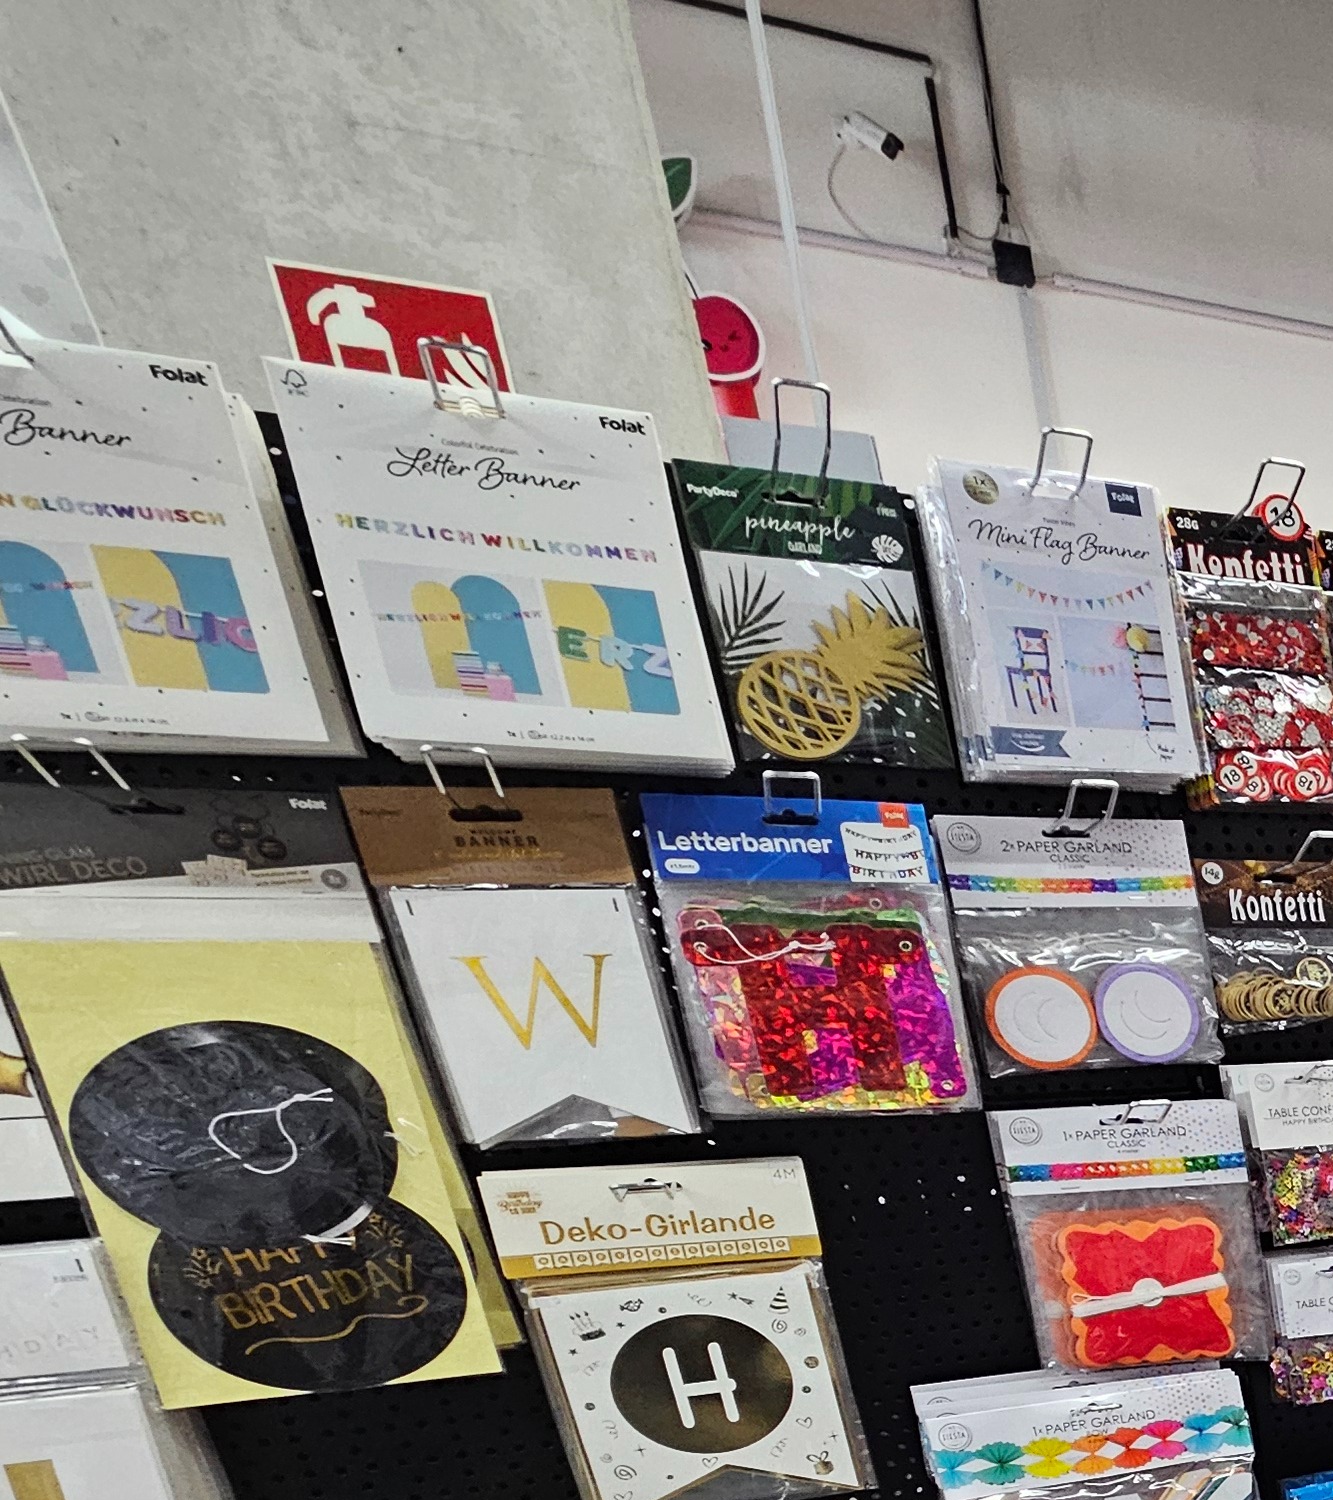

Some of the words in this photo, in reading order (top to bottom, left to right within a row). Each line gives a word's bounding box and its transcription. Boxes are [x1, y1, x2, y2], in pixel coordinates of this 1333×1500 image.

[149, 363, 209, 388] Folat
[0, 408, 131, 447] Banner
[599, 416, 647, 436] Folat
[387, 447, 470, 477] Letter
[474, 457, 581, 490] Banner
[335, 511, 476, 546] HERZLICH
[481, 532, 657, 563] WILLKOMMEN
[745, 514, 855, 541] pineapple
[1176, 516, 1199, 531] 28G
[968, 518, 1027, 547] Mini
[1029, 526, 1074, 565] Flag
[1076, 532, 1150, 561] Banner
[1187, 544, 1305, 585] Konfetti
[657, 830, 832, 854] Letterbanner
[1017, 840, 1059, 853] PAPER
[1064, 840, 1132, 853] GARLAND
[71, 855, 148, 880] DECO
[1228, 889, 1326, 923] Konfetti
[451, 953, 610, 1052] W
[1267, 1107, 1299, 1119] TABLE
[1075, 1129, 1117, 1142] PAPER
[1121, 1126, 1187, 1140] GARLAND
[539, 1207, 776, 1246] Deko-Girlande
[214, 1254, 413, 1329] BIRTHDAY
[1295, 1298, 1326, 1310] TABLE
[662, 1342, 740, 1429] H
[1045, 1419, 1087, 1436] PAPER
[1091, 1410, 1156, 1430] GARLAND
